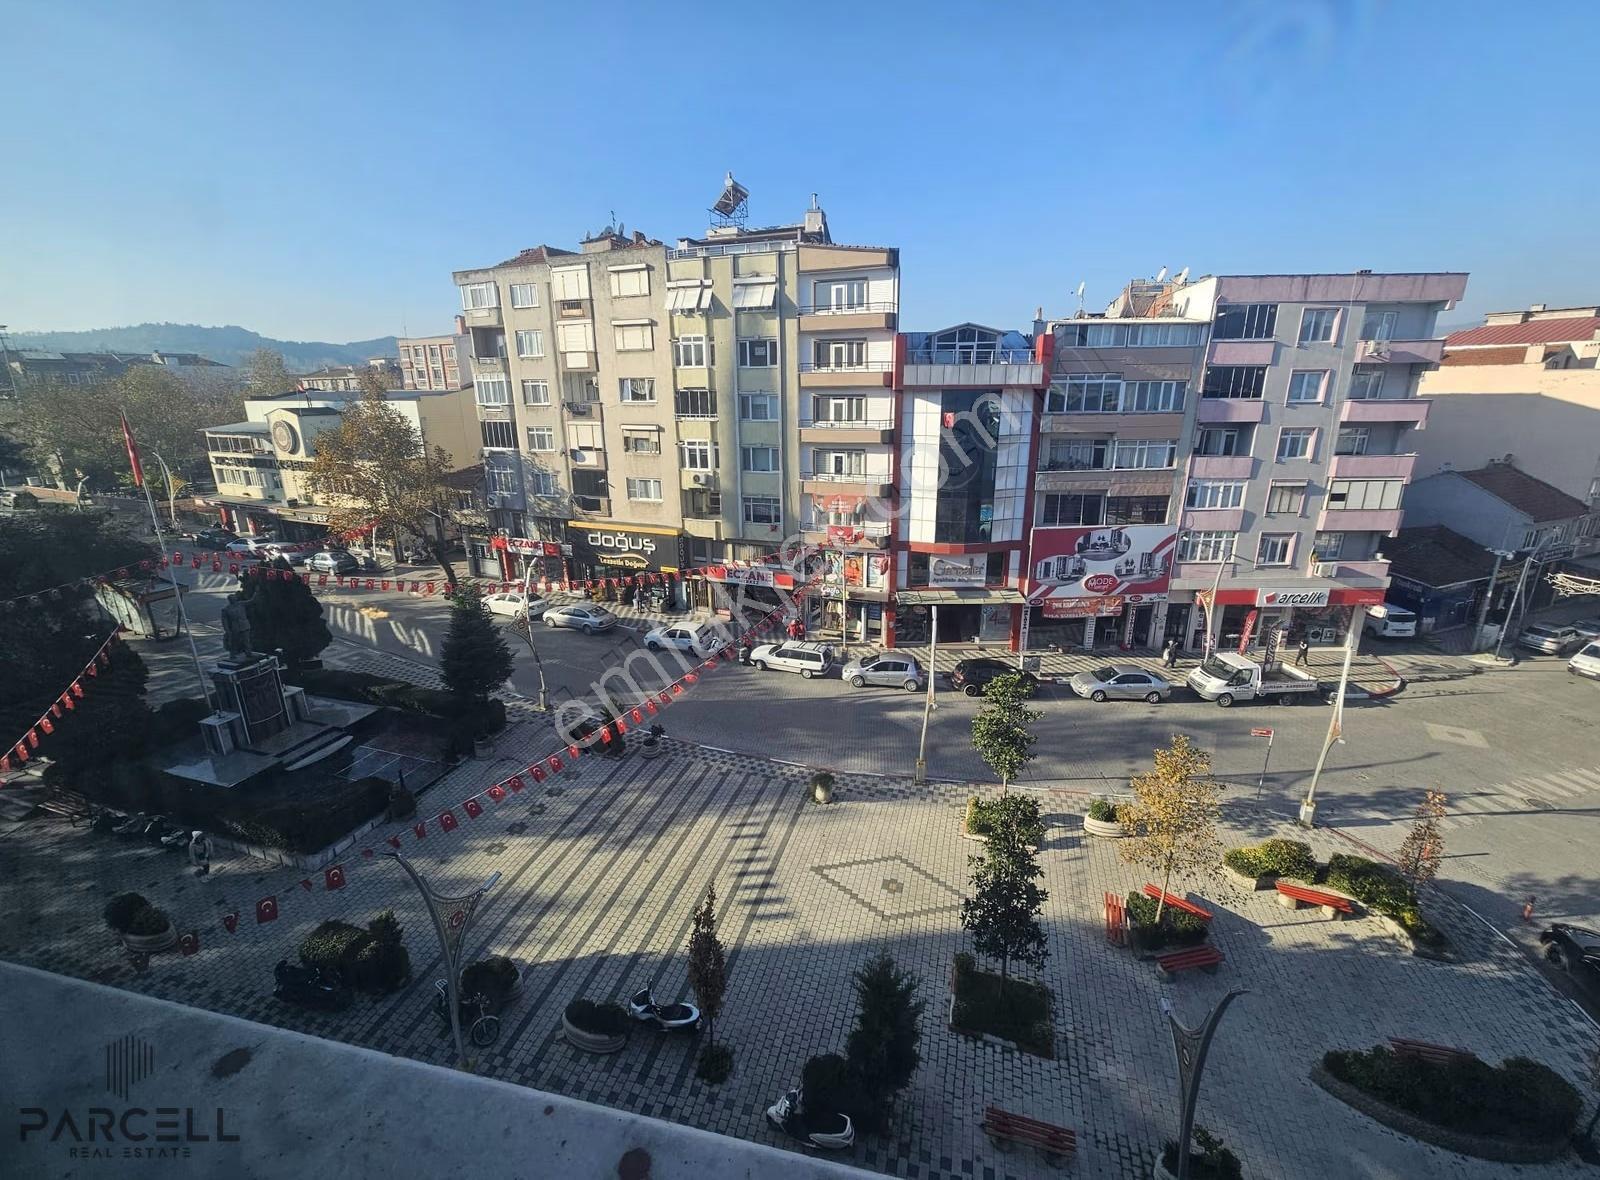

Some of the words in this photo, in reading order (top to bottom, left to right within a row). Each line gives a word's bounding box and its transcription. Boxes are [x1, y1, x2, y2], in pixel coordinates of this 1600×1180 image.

[588, 531, 656, 555] doğuş
[727, 568, 772, 583] ECZANE
[1087, 577, 1114, 588] MODE
